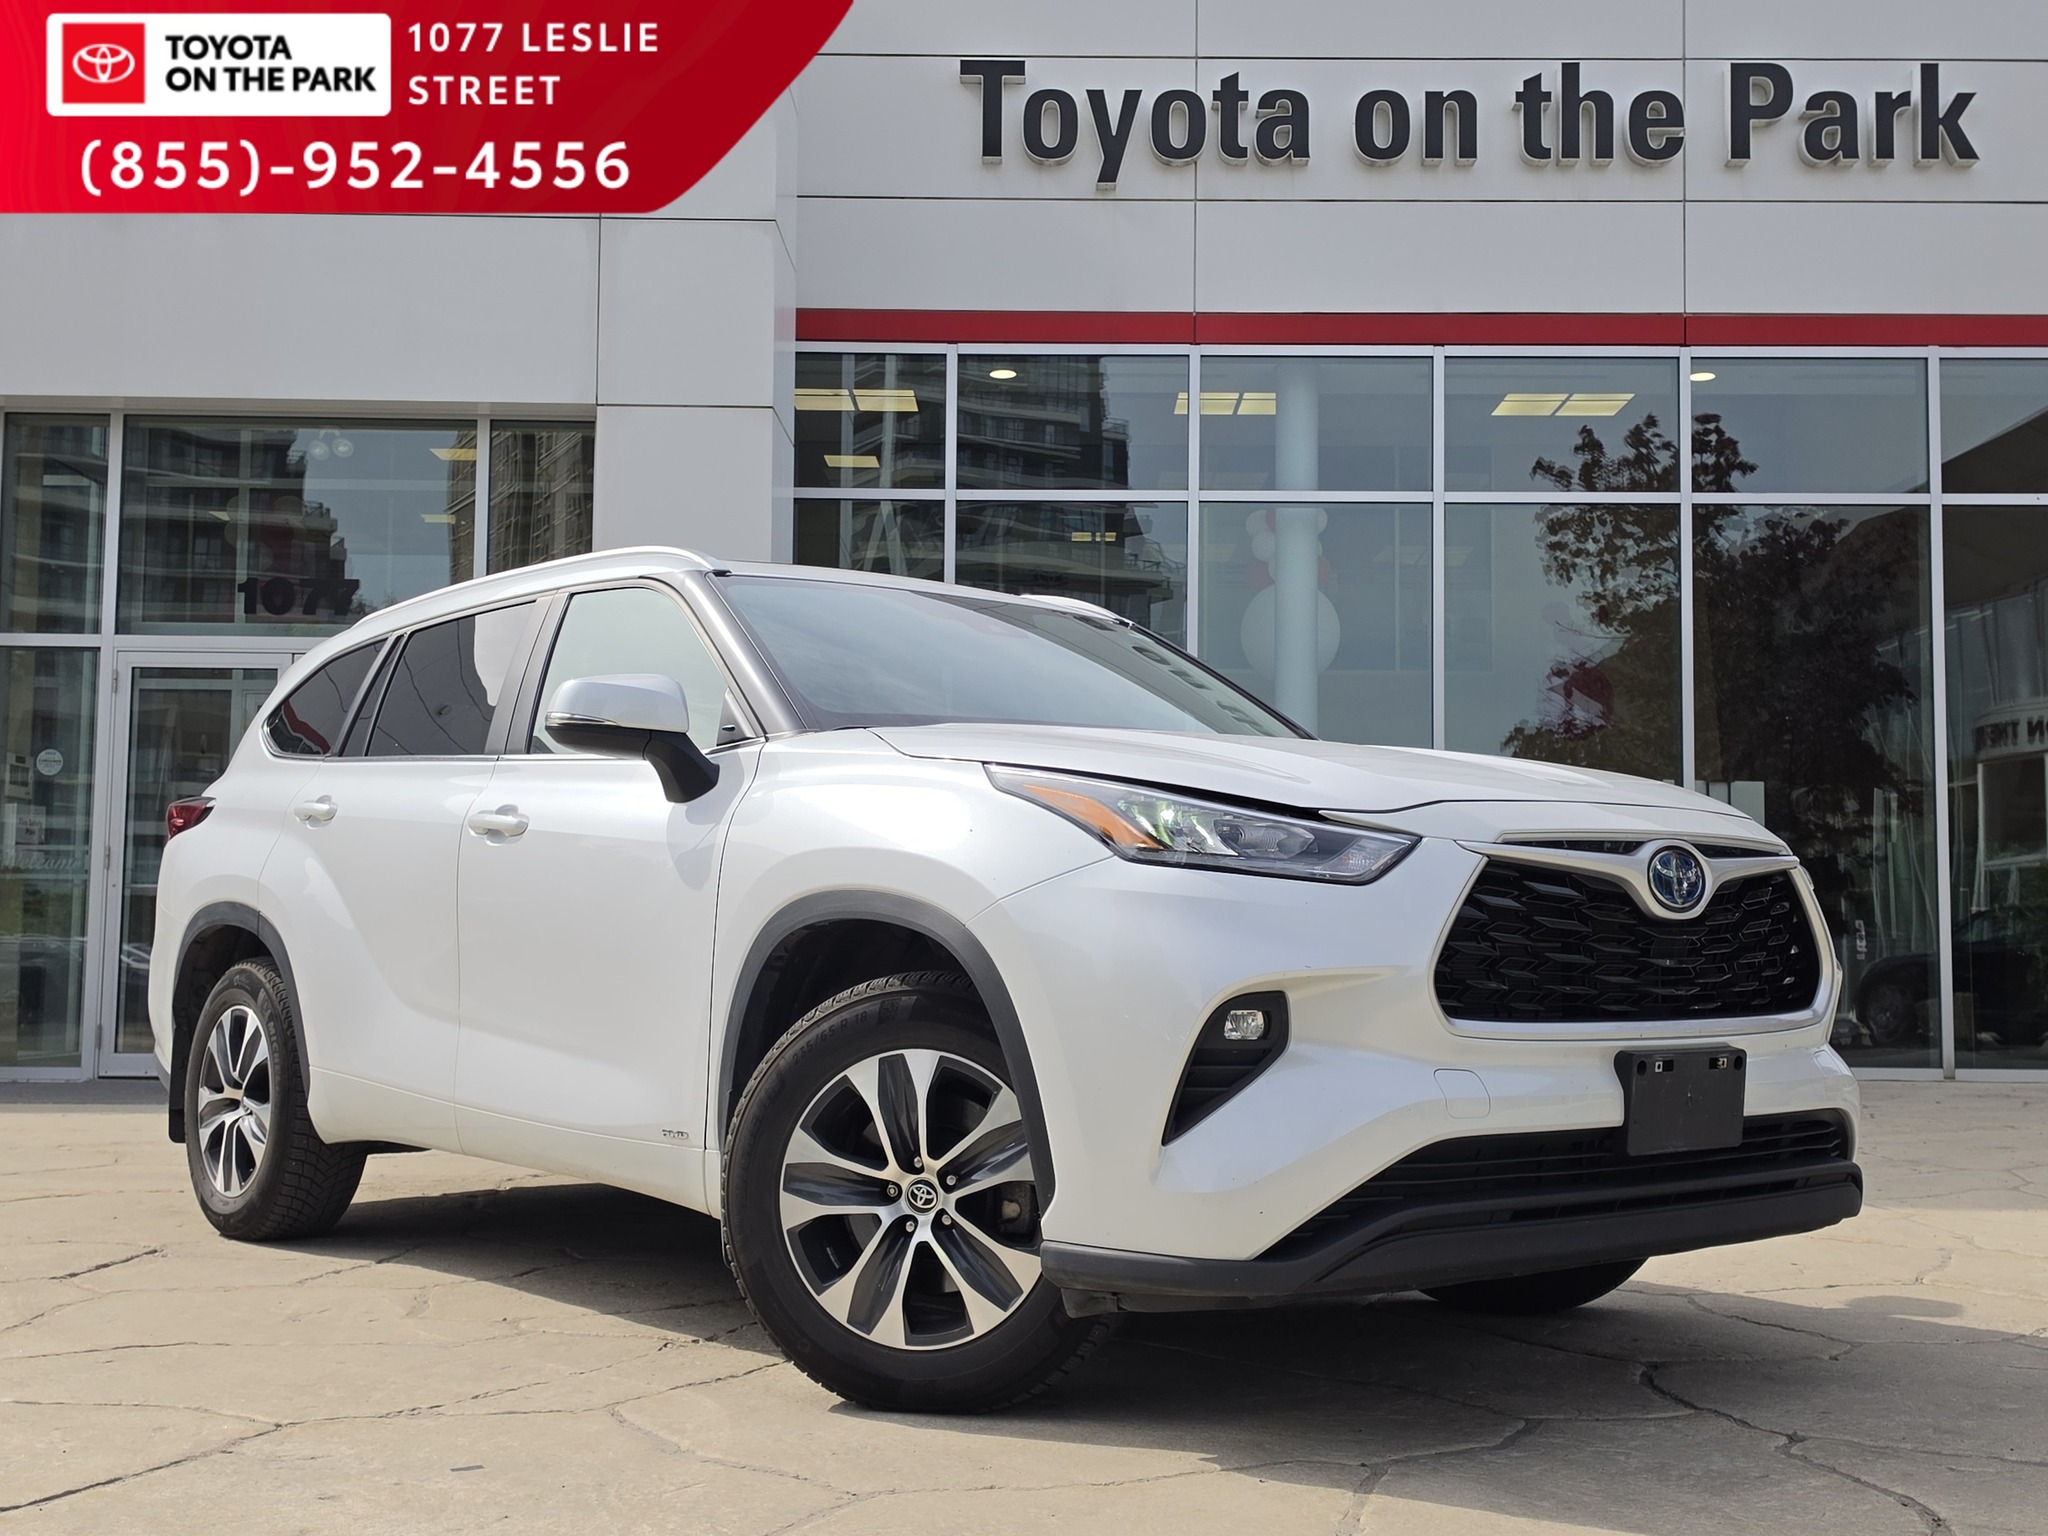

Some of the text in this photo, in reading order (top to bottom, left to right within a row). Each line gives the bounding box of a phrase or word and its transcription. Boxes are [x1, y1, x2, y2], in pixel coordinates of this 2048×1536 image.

[960, 60, 1978, 188] Toyota on the Park
[237, 576, 360, 616] 1077
[840, 1018, 849, 1031] R
[854, 1010, 868, 1025] 18
